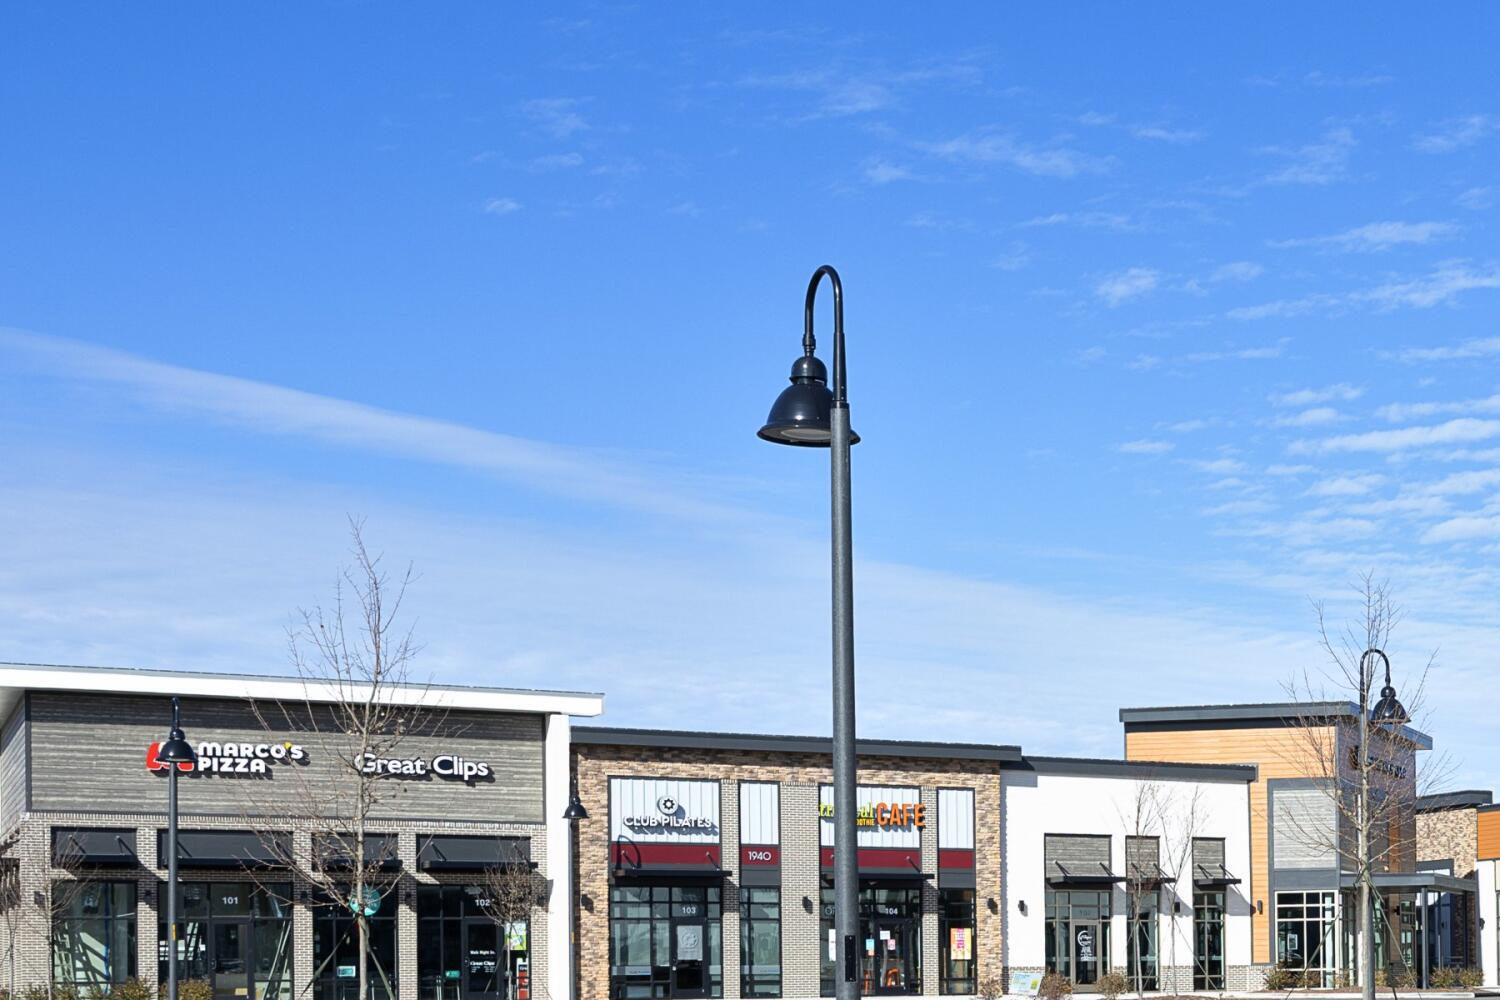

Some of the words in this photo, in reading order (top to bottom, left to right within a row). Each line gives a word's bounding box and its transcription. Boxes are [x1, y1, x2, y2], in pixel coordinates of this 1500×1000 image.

[198, 742, 304, 759] MARCO'S
[198, 757, 266, 773] PIZZA
[354, 753, 426, 775] Great
[433, 755, 489, 781] Clips
[876, 802, 926, 826] CAFE
[624, 816, 657, 827] CLUB
[661, 817, 712, 828] PILATES
[748, 851, 772, 861] 1940
[222, 896, 239, 905] 101
[475, 899, 490, 907] 102
[682, 906, 696, 914] 103
